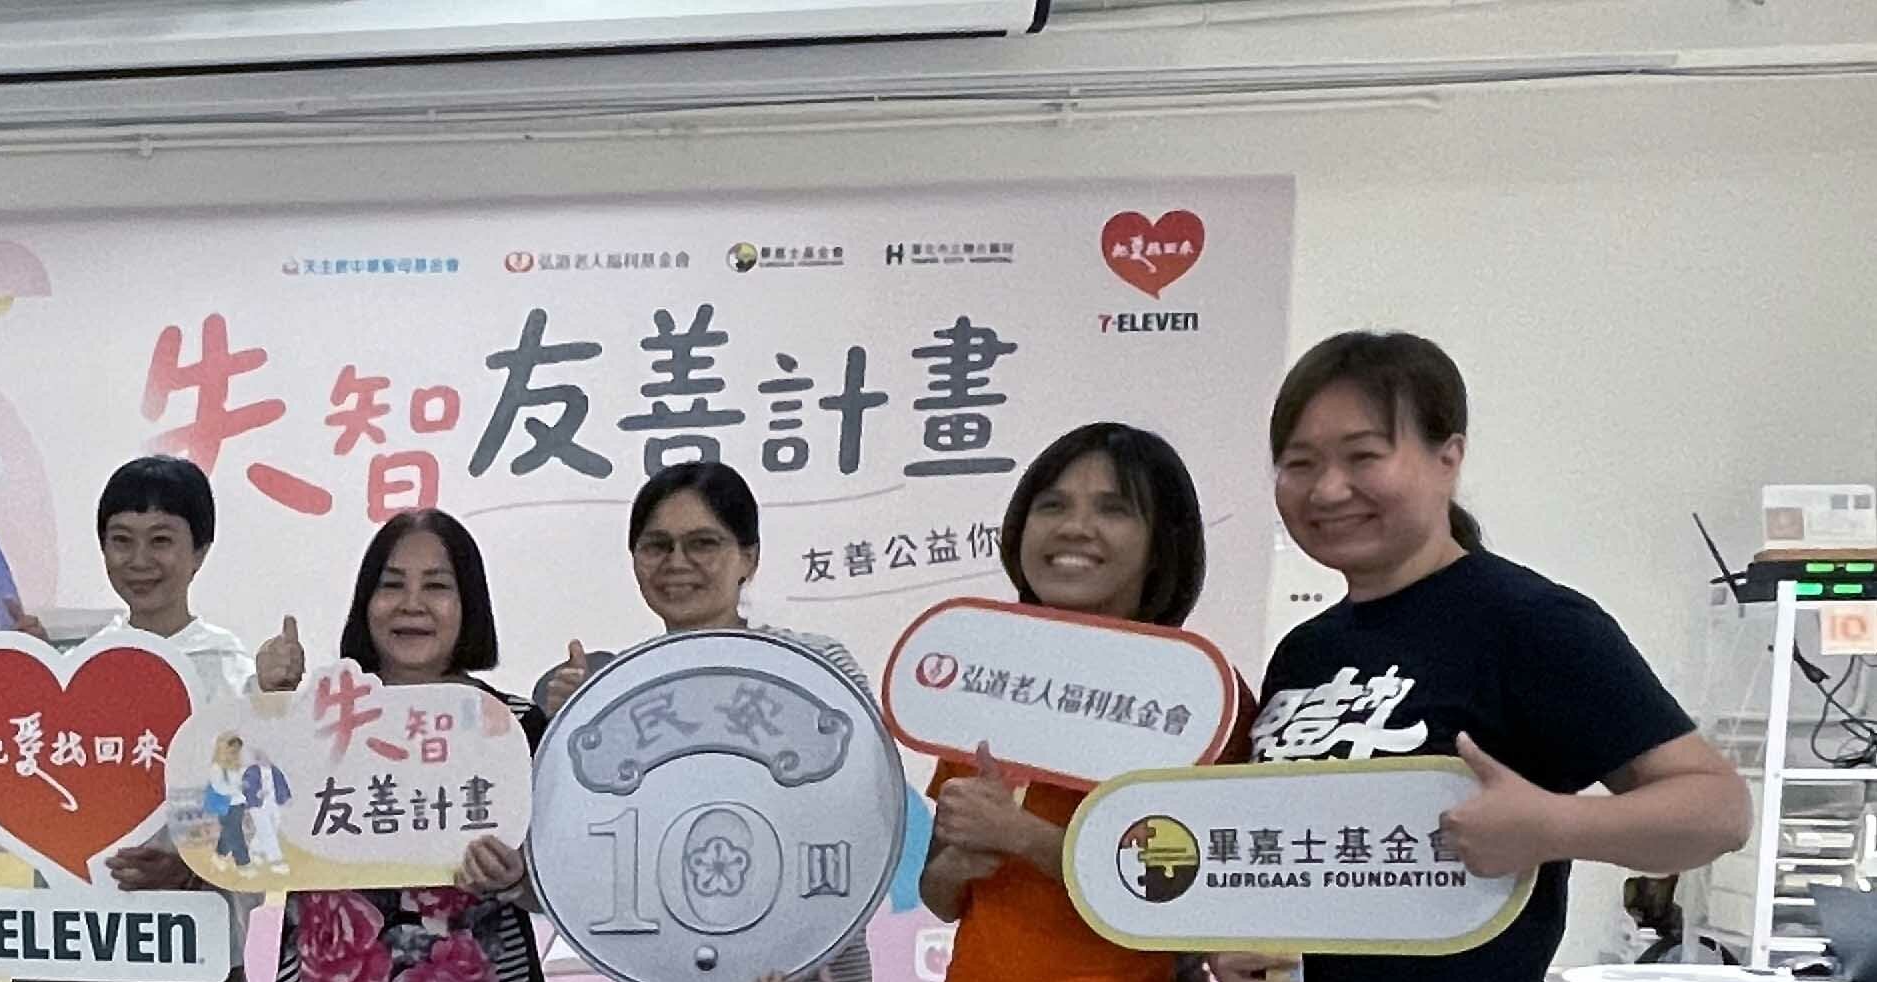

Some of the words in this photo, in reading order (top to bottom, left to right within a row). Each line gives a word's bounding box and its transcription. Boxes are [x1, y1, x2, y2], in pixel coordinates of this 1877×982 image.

[313, 668, 454, 764] 失智
[960, 664, 1193, 737] 弘道老人福利基金會
[310, 773, 499, 836] 友善計畫
[1323, 871, 1467, 888] FOUNDATION
